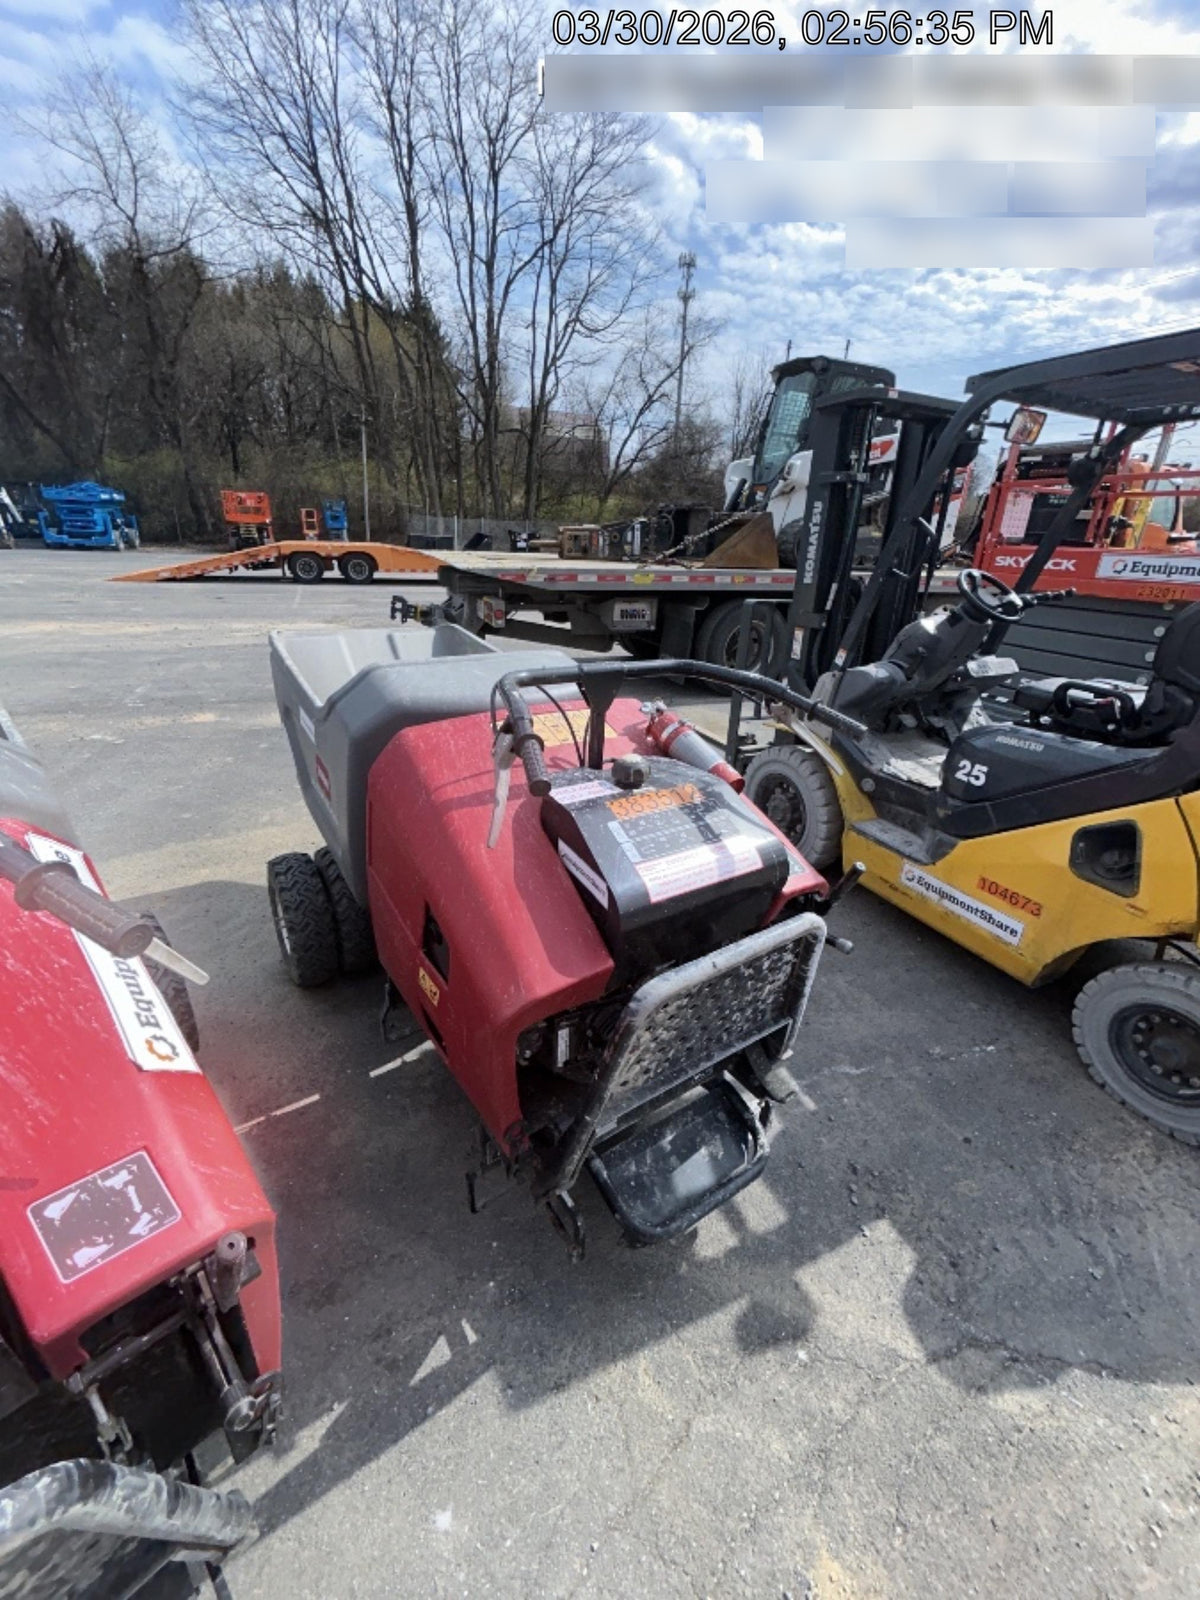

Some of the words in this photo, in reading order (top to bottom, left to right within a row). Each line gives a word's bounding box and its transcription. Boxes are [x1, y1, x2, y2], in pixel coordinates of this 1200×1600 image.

[803, 500, 823, 584] KOMATSU
[994, 552, 1076, 572] SKYCK
[995, 735, 1045, 752] KOMATSU
[954, 759, 989, 787] 25
[978, 876, 1044, 918] 104673
[114, 956, 163, 1032] Equip
